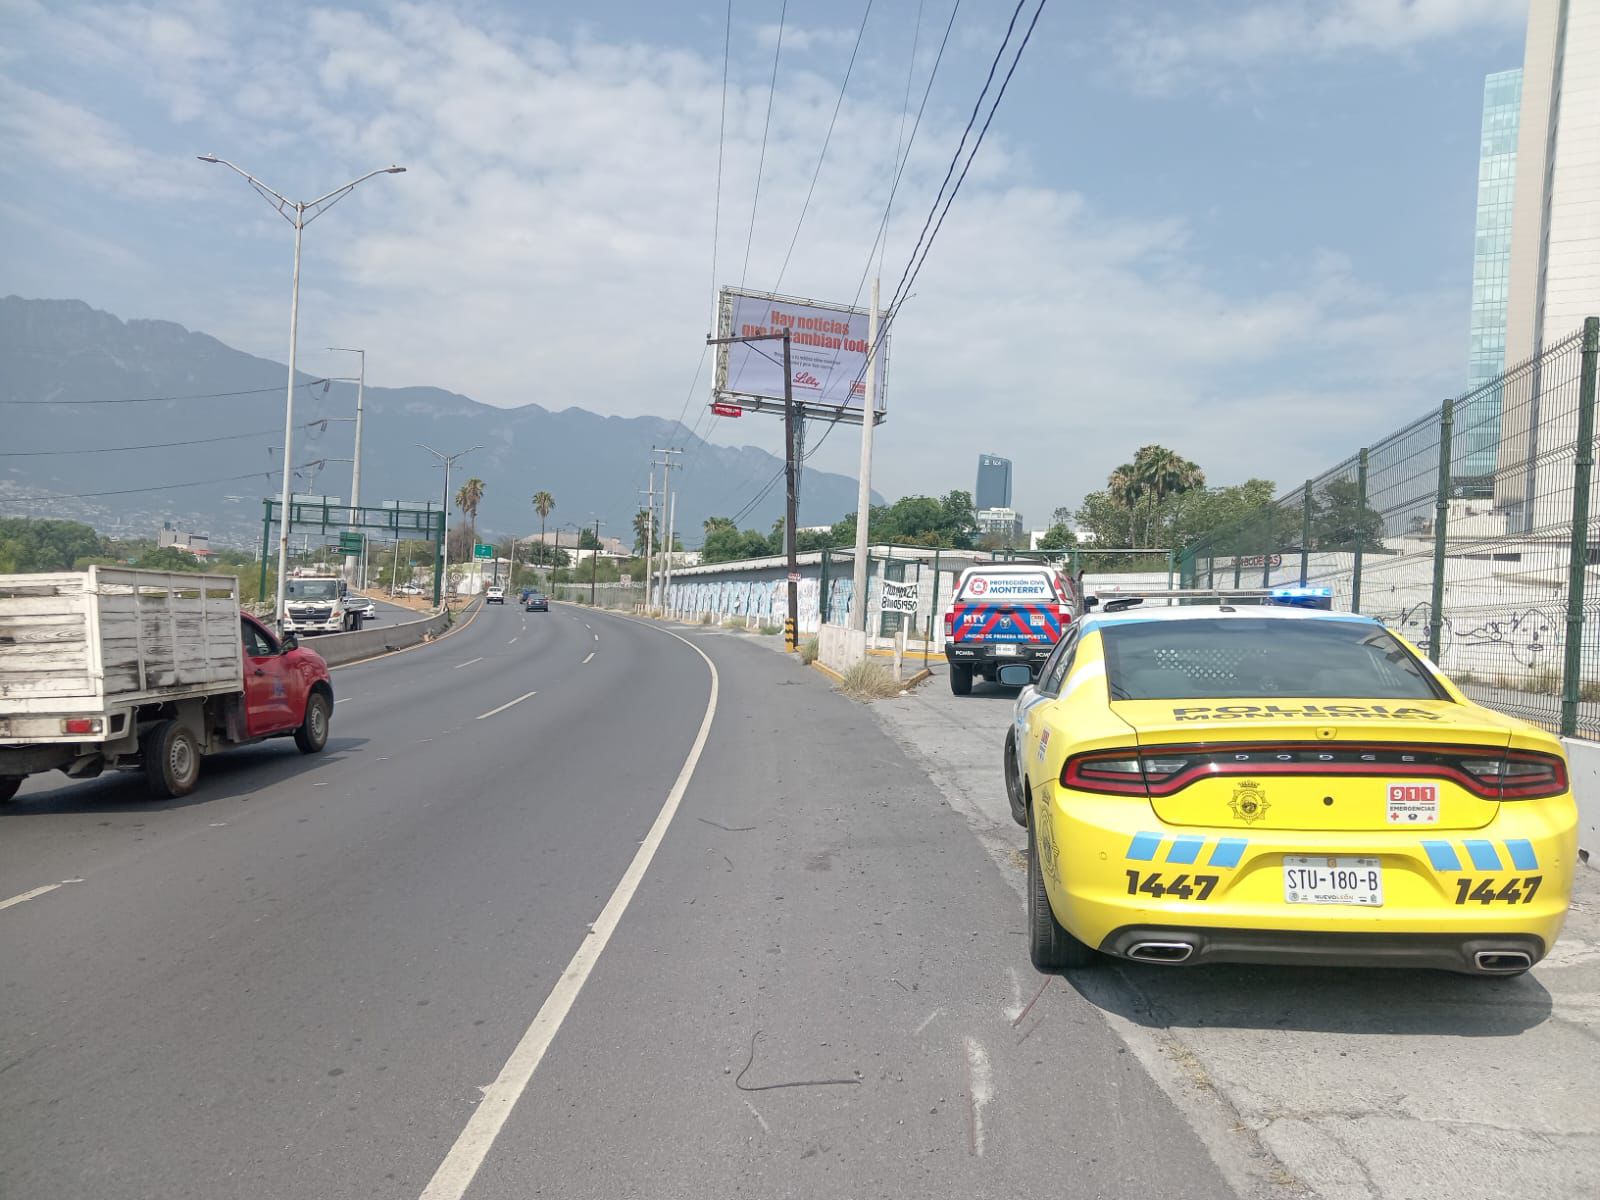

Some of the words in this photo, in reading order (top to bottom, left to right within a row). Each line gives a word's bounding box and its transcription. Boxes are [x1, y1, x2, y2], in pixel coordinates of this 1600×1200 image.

[771, 310, 795, 328] Hay
[797, 316, 850, 335] noticias
[742, 323, 767, 338] que
[793, 371, 820, 387] Lilly
[990, 586, 1045, 594] MONTERREY
[963, 614, 986, 623] MTY
[1175, 712, 1443, 722] MONTERREY
[1235, 753, 1415, 762] DODGE
[1392, 788, 1432, 801] 911
[1125, 869, 1220, 902] 1447
[1287, 869, 1378, 891] STU-180-B
[1455, 875, 1543, 906] 1447
